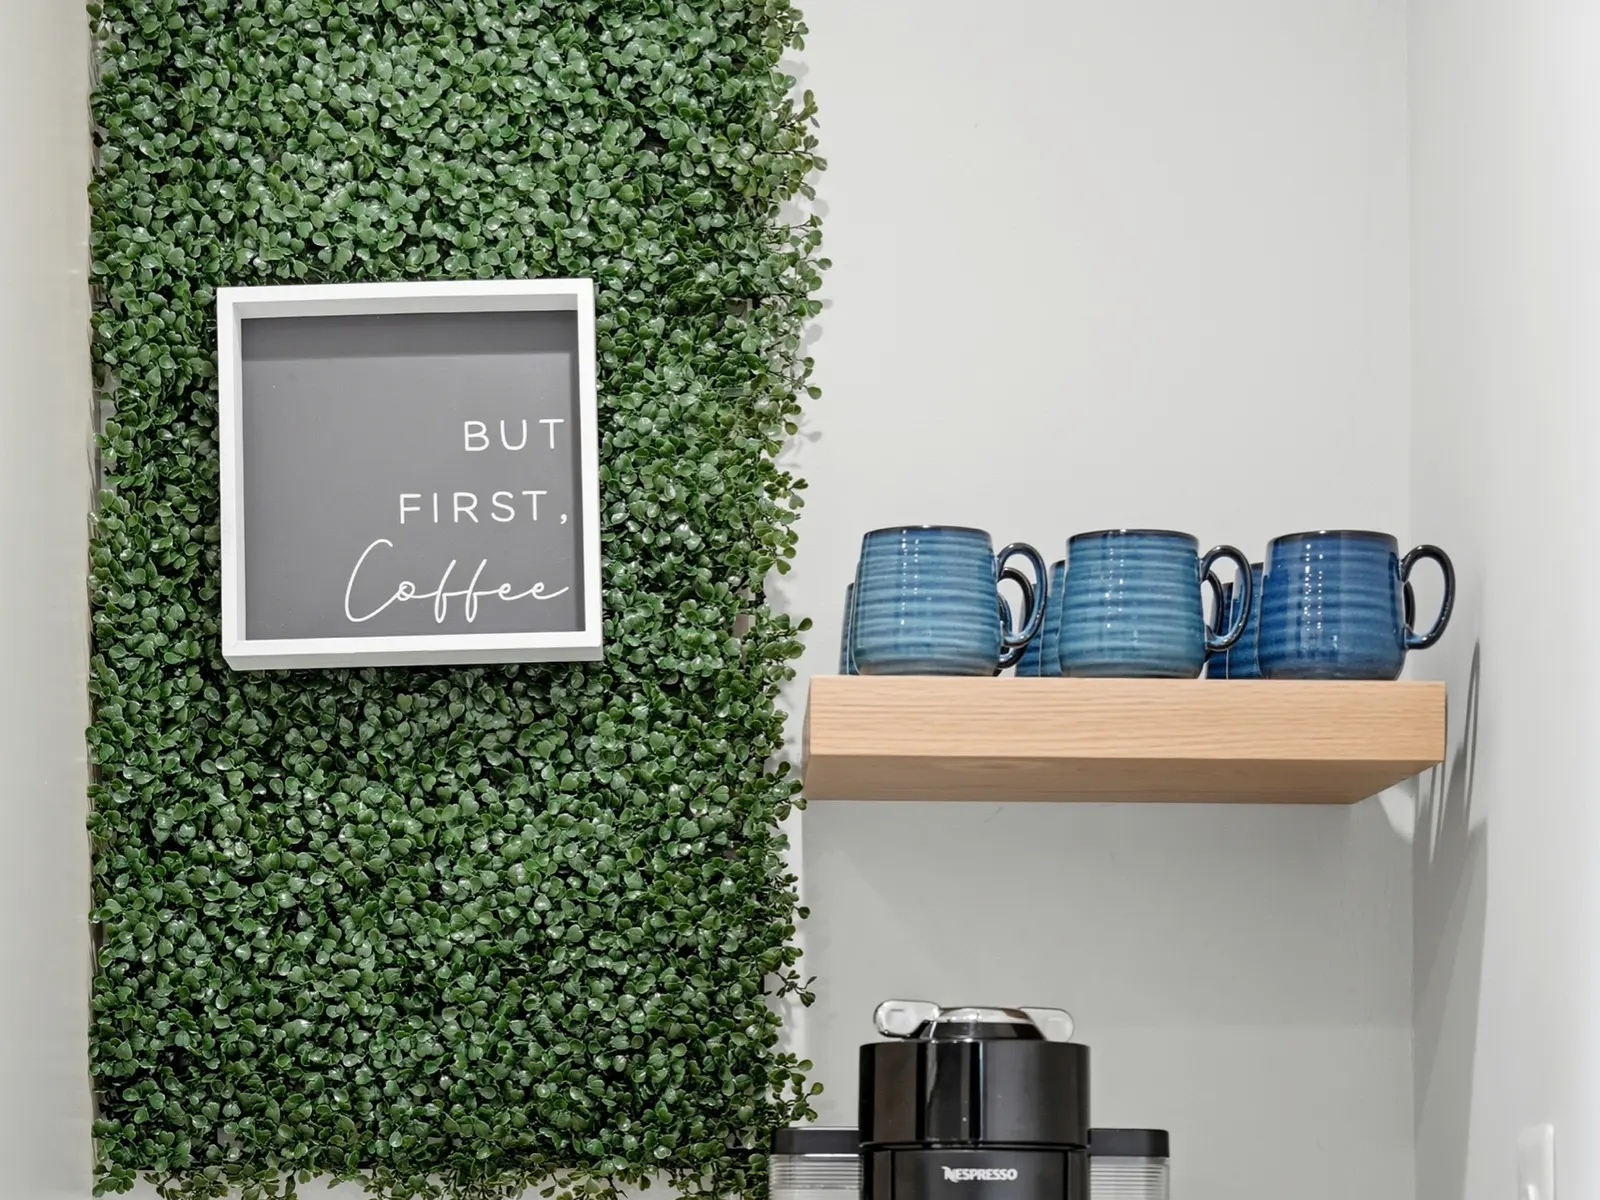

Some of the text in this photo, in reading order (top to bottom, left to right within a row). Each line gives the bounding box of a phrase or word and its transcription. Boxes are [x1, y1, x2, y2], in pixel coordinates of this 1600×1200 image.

[463, 418, 565, 452] BUT
[399, 490, 568, 525] FIRST,
[344, 538, 570, 624] Coffee
[941, 1165, 1018, 1183] NESPRESSO
